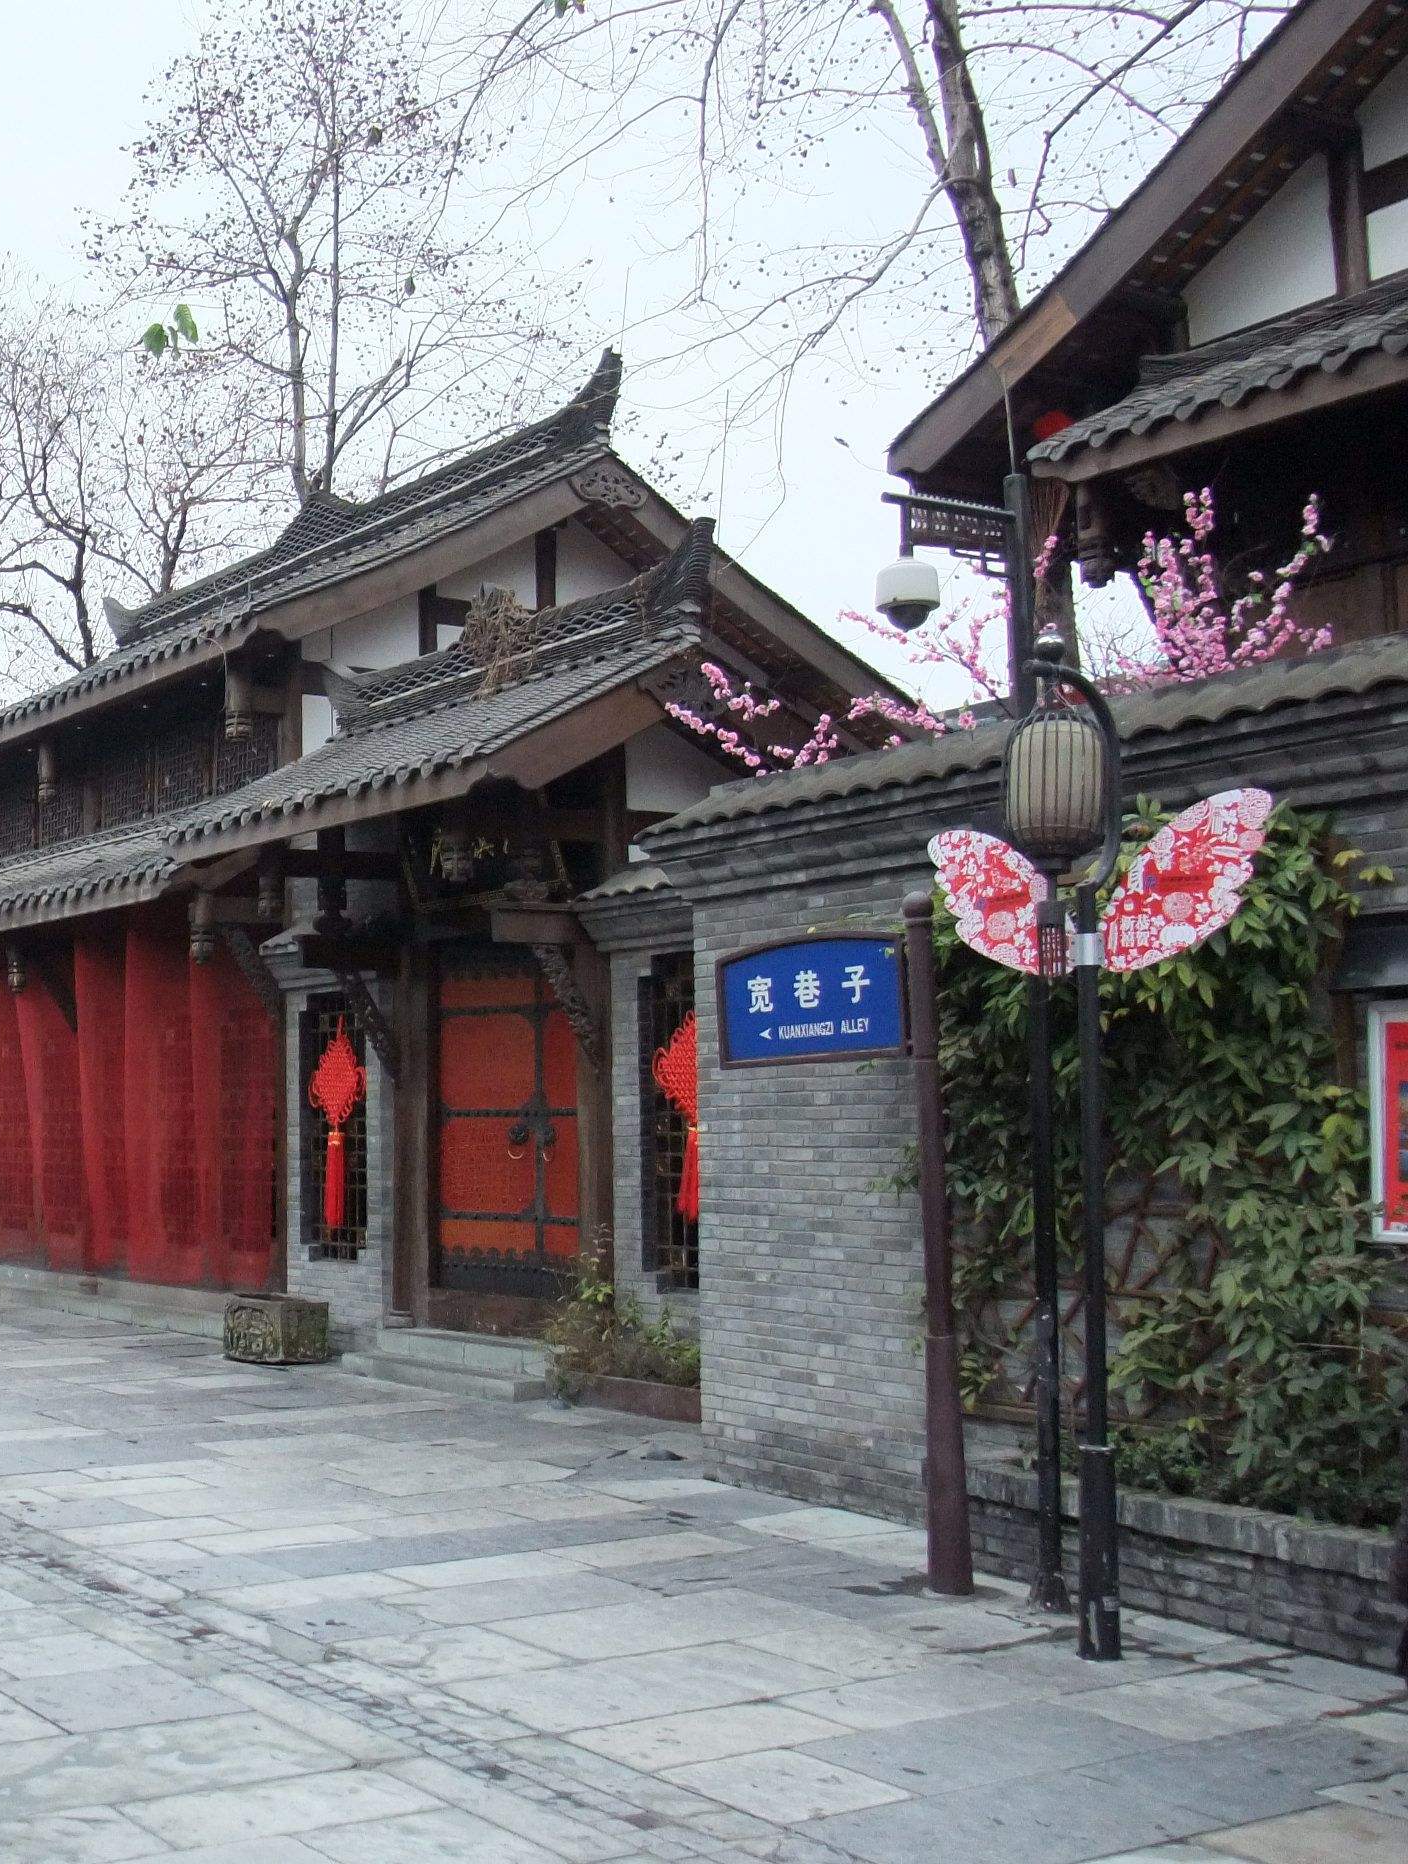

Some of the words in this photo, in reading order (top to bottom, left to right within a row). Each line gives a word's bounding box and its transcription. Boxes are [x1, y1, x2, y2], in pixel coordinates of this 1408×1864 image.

[746, 964, 871, 1014] 宽巷子
[778, 1021, 834, 1041] KUANXIANGZI
[841, 1017, 869, 1034] ALLEY
